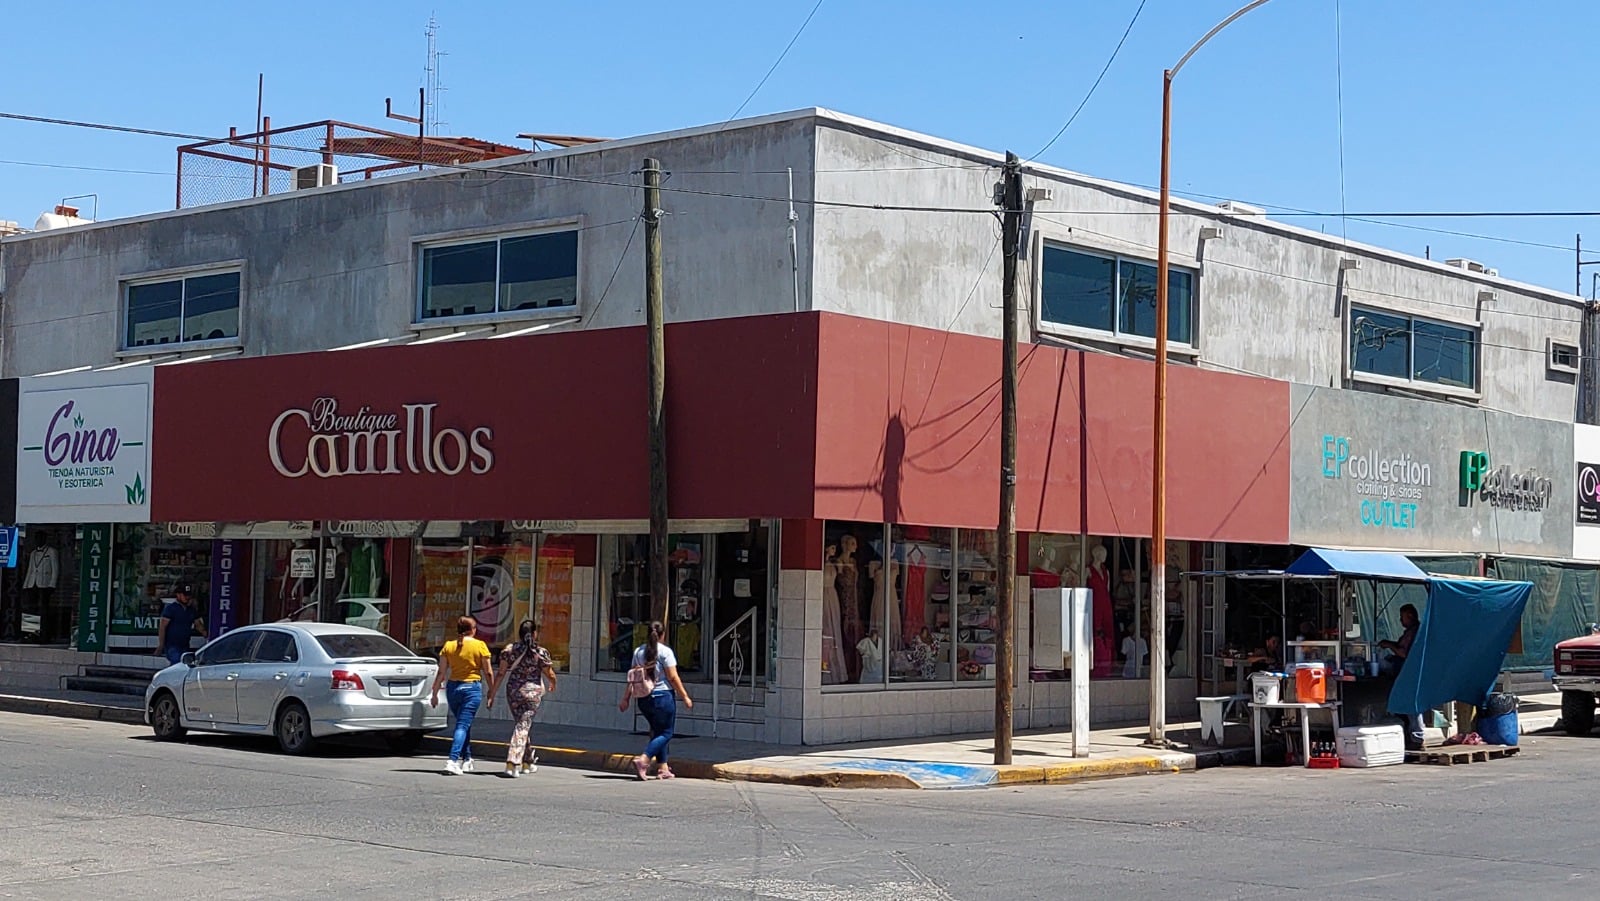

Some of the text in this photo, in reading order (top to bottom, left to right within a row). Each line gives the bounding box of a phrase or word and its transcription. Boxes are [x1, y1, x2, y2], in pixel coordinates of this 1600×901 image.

[311, 397, 396, 432] Boutique
[45, 400, 120, 466] Gina
[48, 466, 114, 478] TIENDA NATURISTA
[58, 478, 104, 488] Y ESOTERICA
[1389, 484, 1397, 497] &
[1398, 485, 1422, 499] shoes
[1361, 499, 1418, 528] OUTLET
[86, 529, 102, 643] NATURISTA
[219, 538, 233, 635] SOTERI
